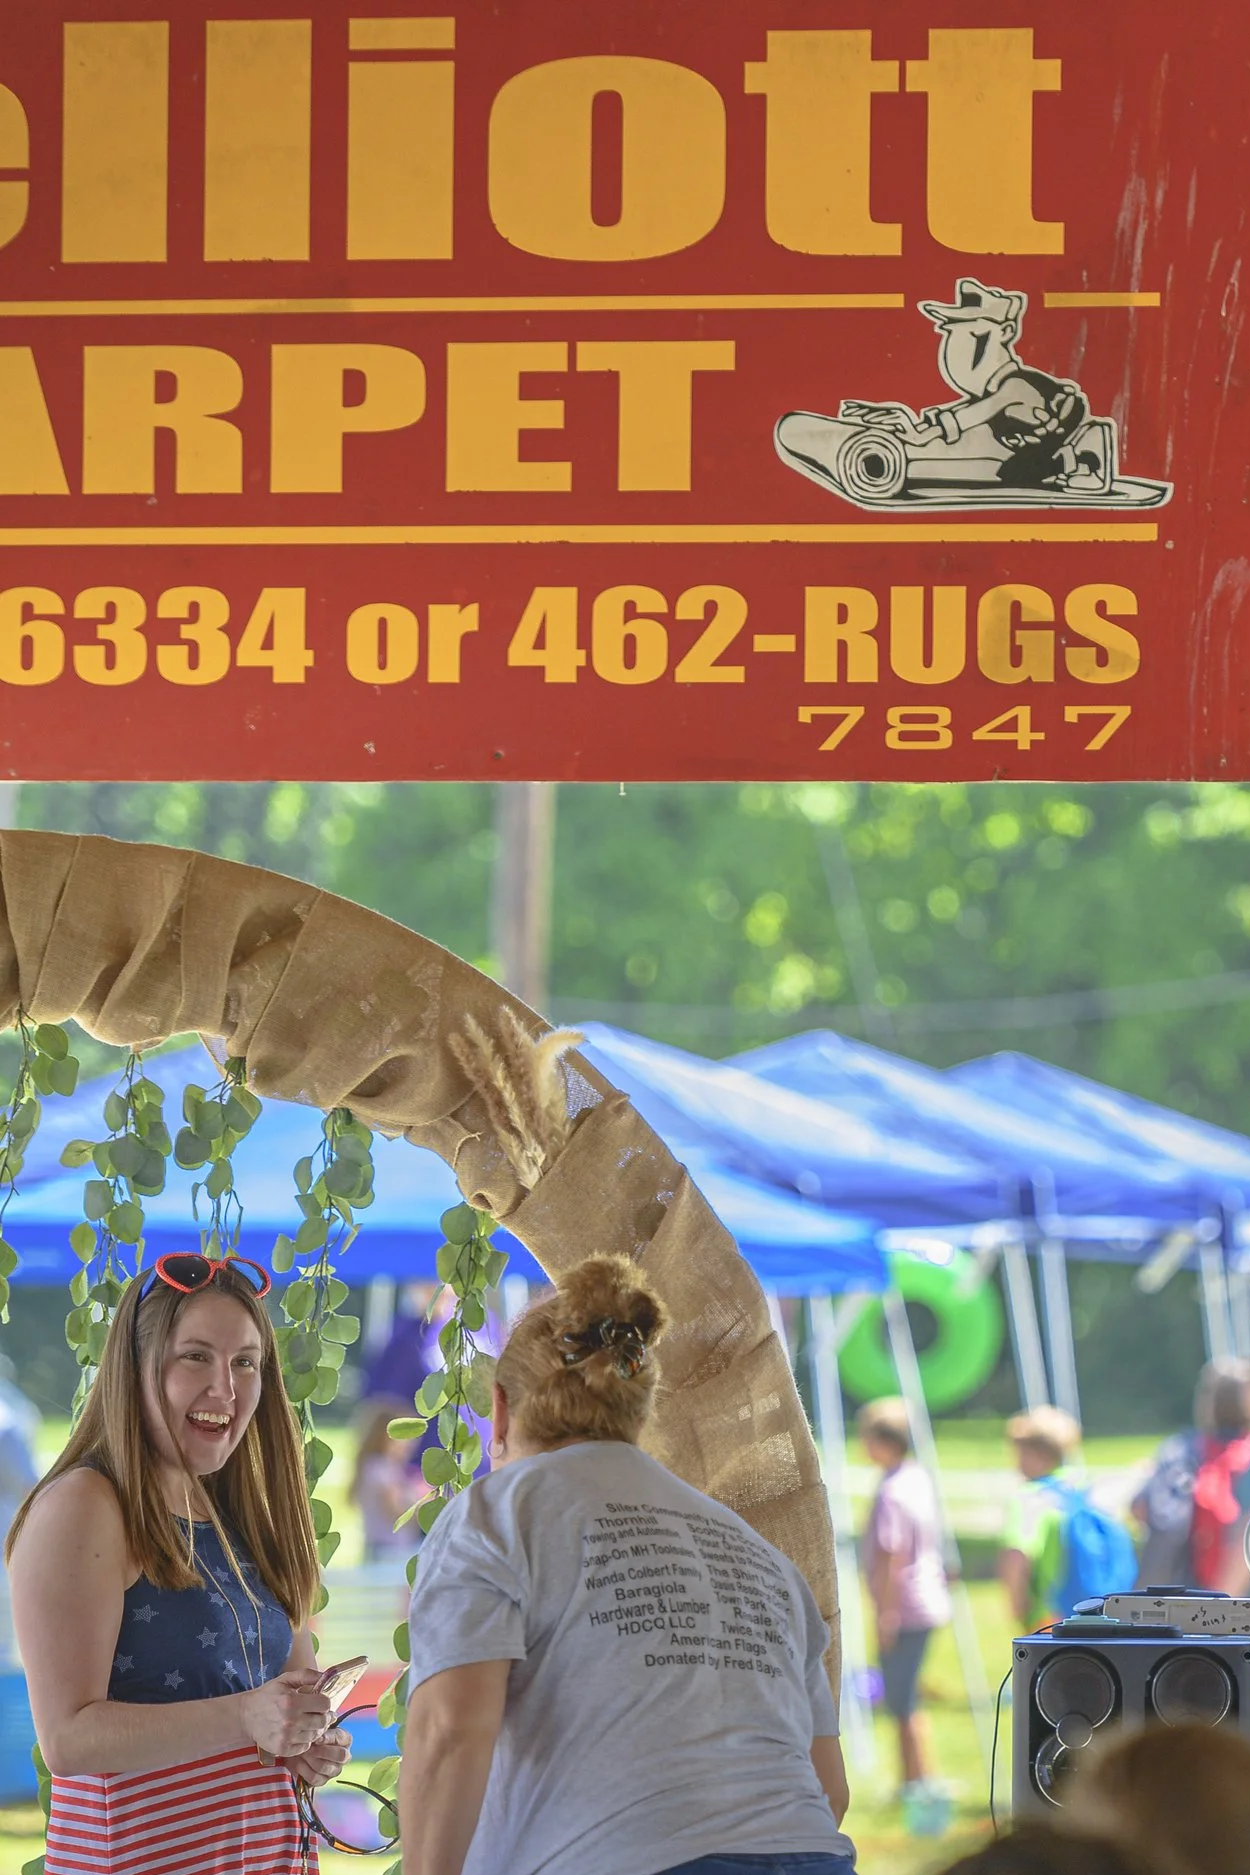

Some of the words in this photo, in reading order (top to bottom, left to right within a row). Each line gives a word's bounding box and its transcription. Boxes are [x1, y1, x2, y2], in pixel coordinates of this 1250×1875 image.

[0, 17, 1064, 263] lliott
[346, 602, 478, 685] or
[506, 584, 1141, 684] 462-RUGS
[798, 705, 1133, 752] 7847
[605, 1502, 639, 1514] Silex
[594, 1516, 659, 1529] Thornhill
[629, 1544, 651, 1559] MH
[585, 1571, 626, 1591] Wanda
[627, 1565, 671, 1581] Colbert
[614, 1581, 687, 1601] Baragiola
[589, 1603, 655, 1627] Hardware
[657, 1598, 668, 1614] &
[669, 1599, 712, 1615] Lumber
[668, 1615, 697, 1630] LLC
[670, 1632, 732, 1650] American
[734, 1638, 768, 1657] Flags
[645, 1651, 706, 1668] Donated
[723, 1655, 754, 1671] Fred
